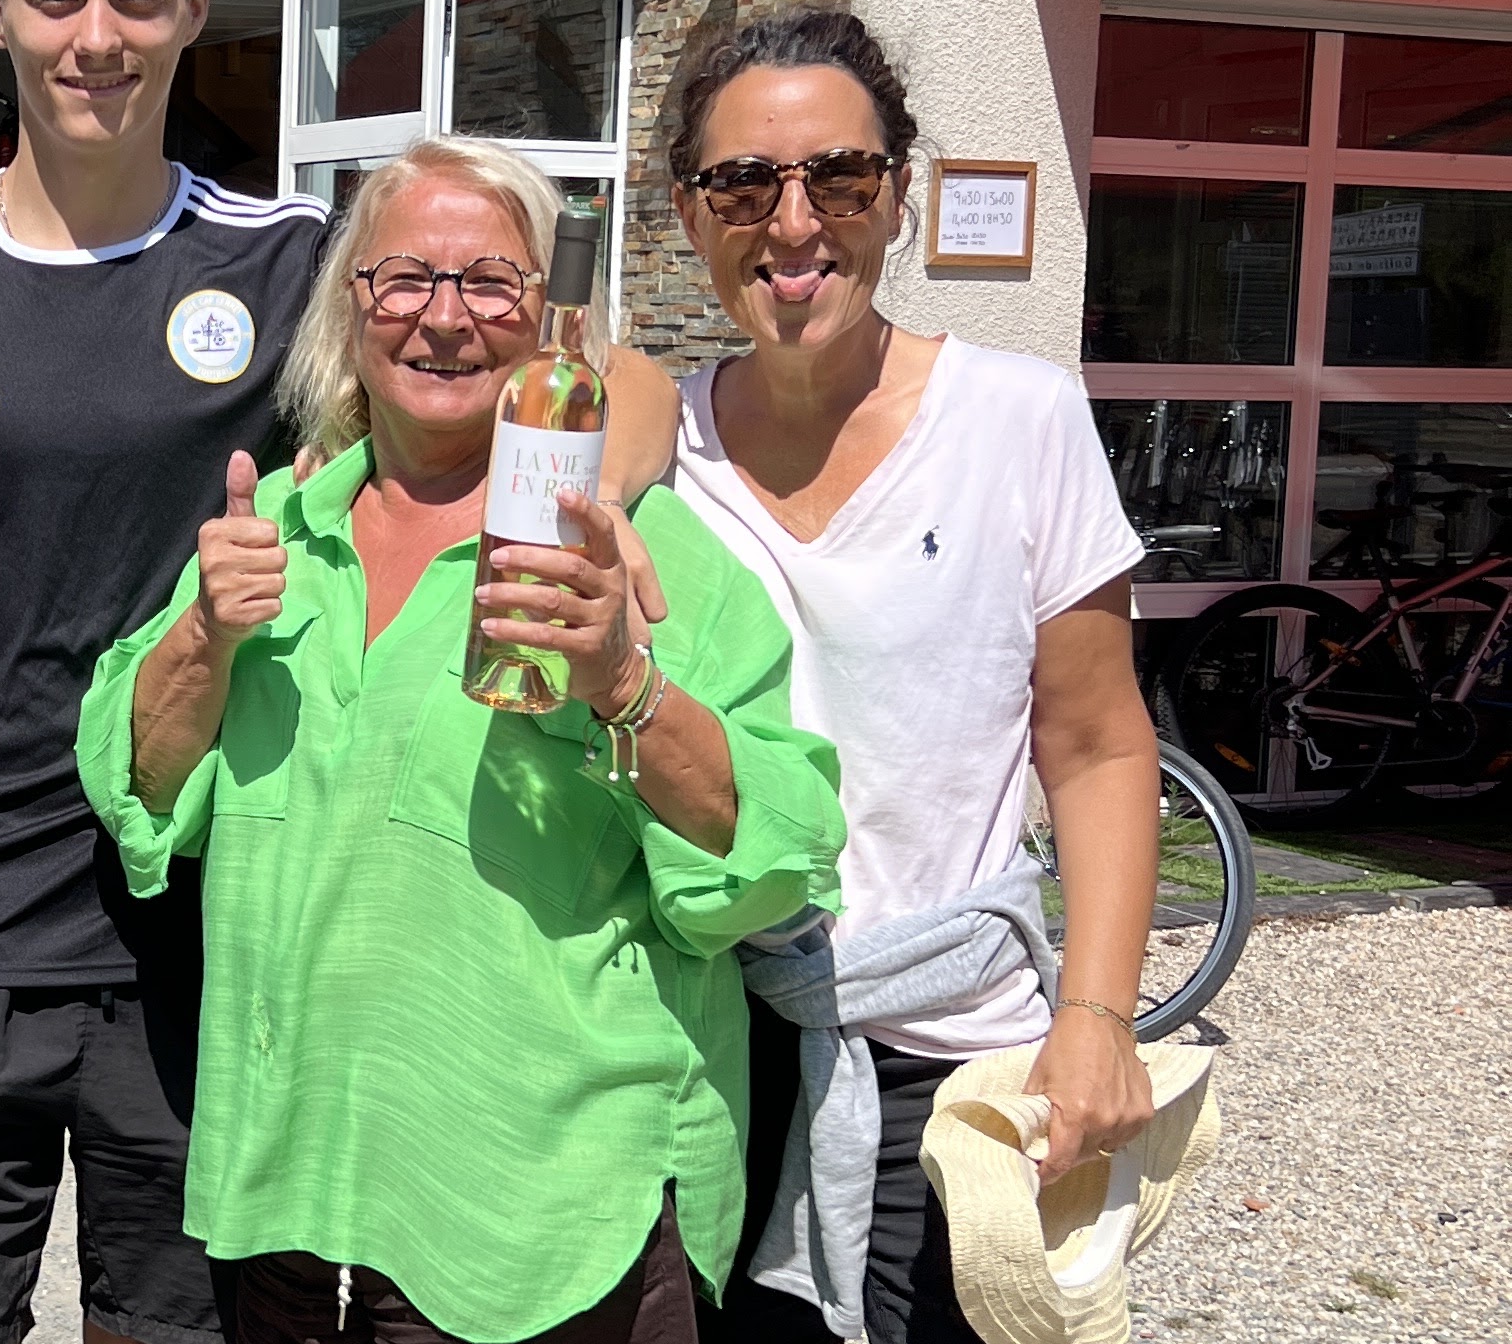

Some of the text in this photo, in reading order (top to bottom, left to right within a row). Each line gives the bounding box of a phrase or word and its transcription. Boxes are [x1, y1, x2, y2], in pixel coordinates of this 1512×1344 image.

[514, 448, 541, 472] LA
[549, 452, 583, 475] VIE
[511, 473, 536, 496] EN
